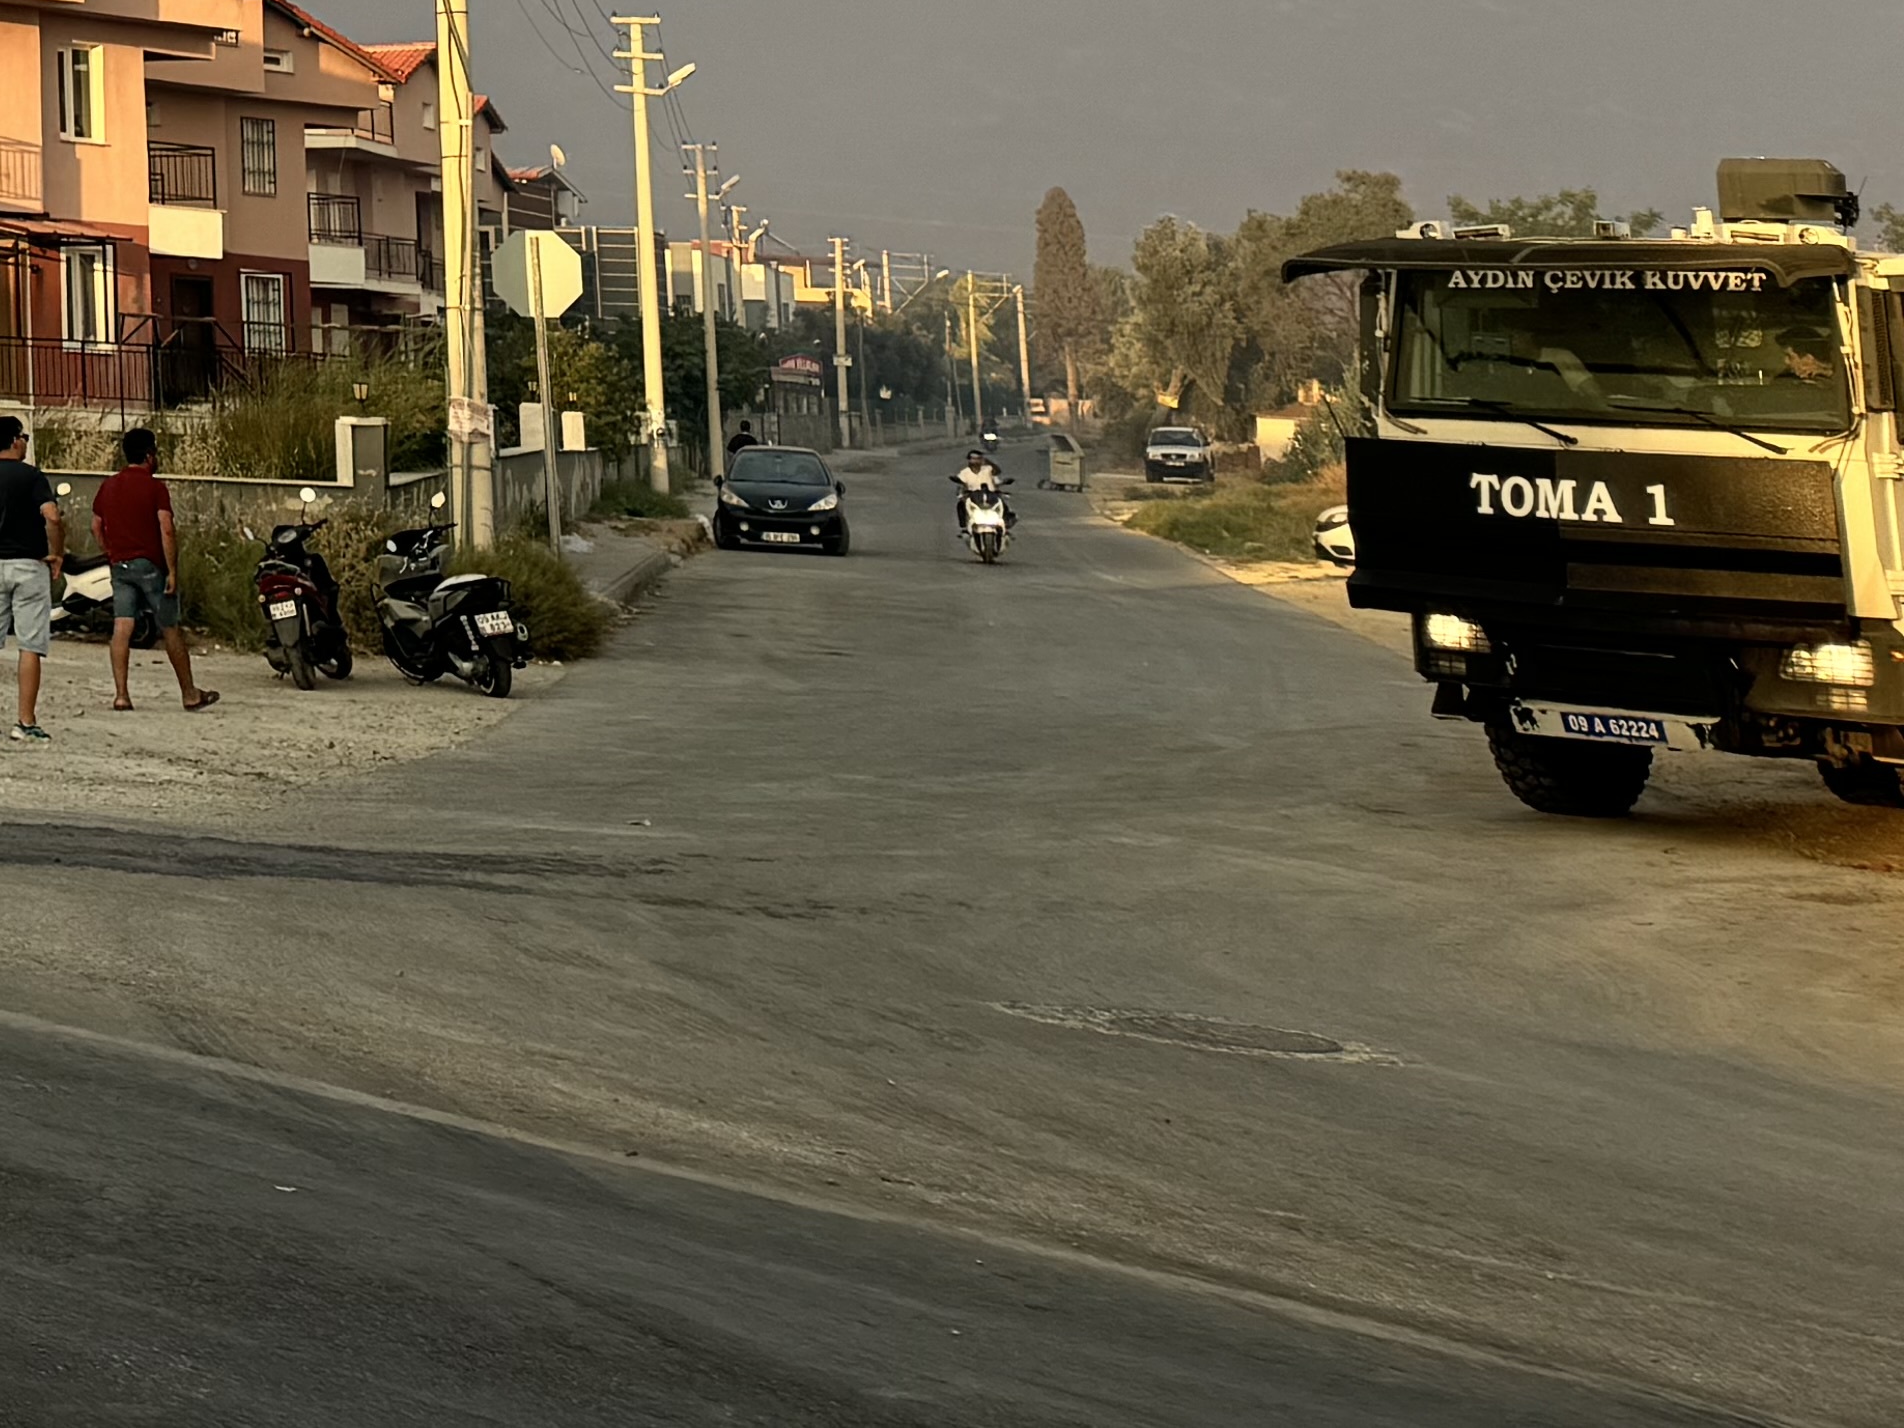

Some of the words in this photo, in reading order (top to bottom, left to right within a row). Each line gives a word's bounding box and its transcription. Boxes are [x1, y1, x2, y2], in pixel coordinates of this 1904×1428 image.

[1448, 270, 1534, 288] AYDIN
[1644, 270, 1767, 292] KUVVET
[1469, 472, 1623, 523] TOMA
[1646, 484, 1675, 526] 1
[1568, 714, 1589, 732] 09
[1593, 717, 1606, 734] A
[1610, 719, 1660, 740] 62224
